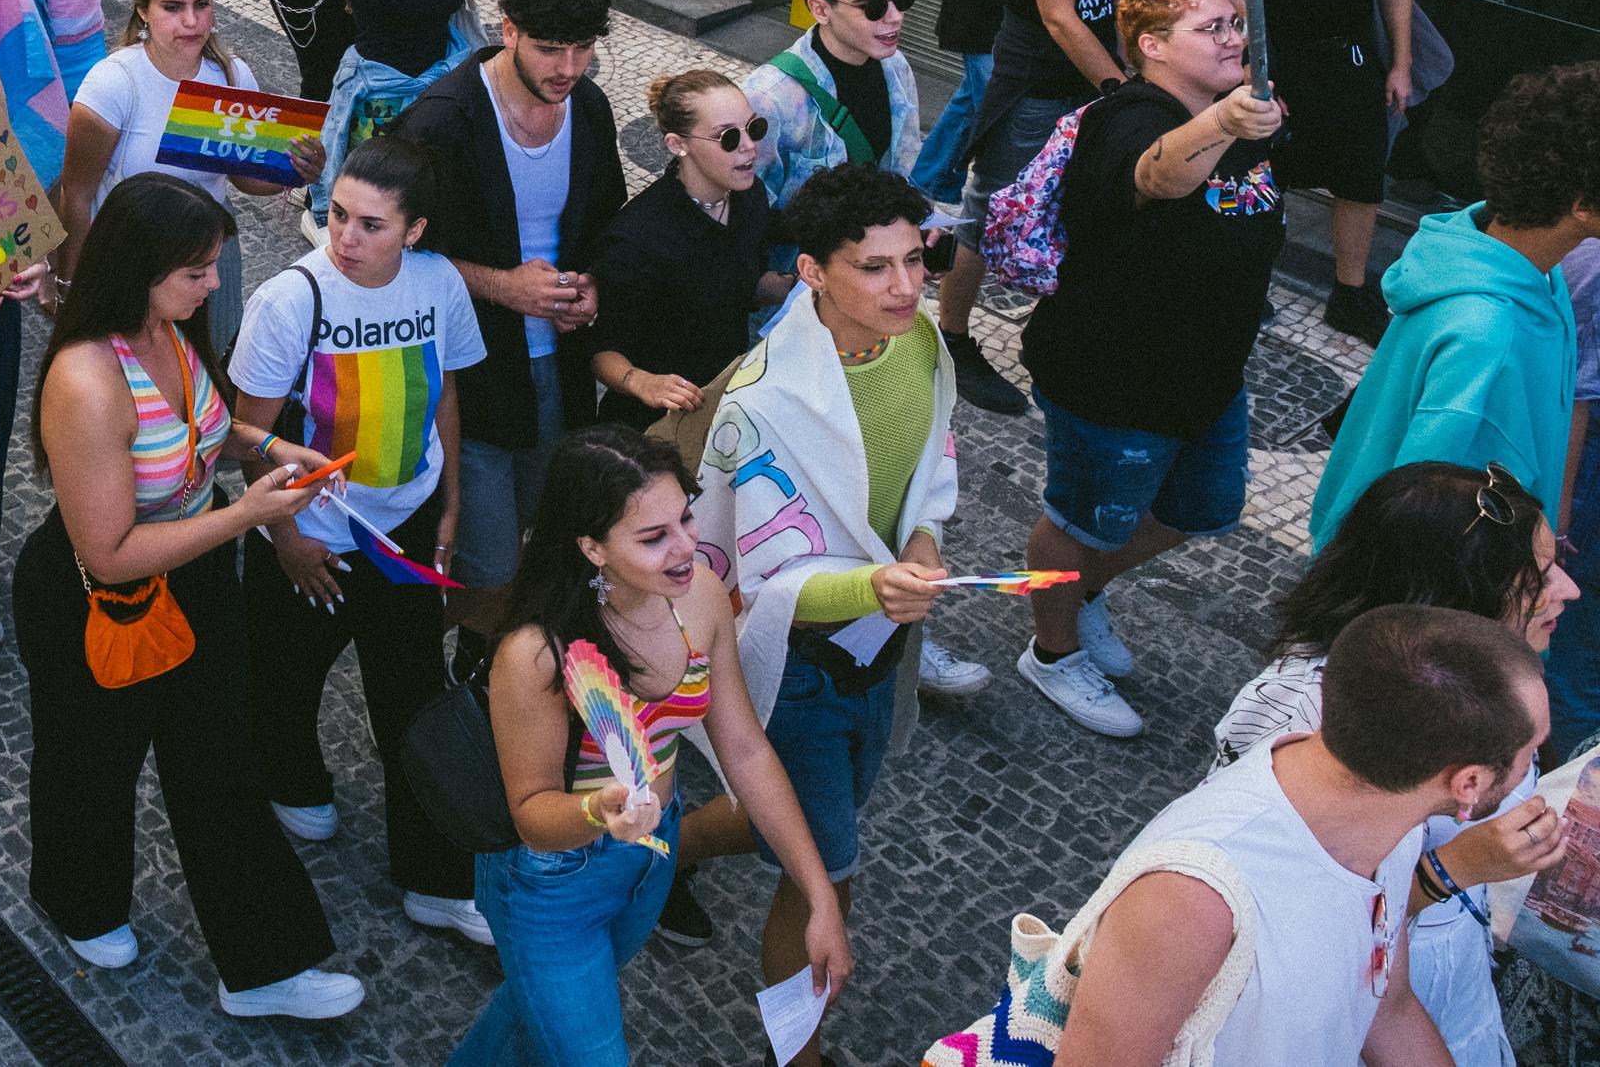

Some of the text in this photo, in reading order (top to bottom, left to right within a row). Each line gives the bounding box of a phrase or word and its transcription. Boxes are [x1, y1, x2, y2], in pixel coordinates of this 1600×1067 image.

[213, 98, 283, 124] LOVE
[218, 116, 262, 141] IS
[199, 137, 268, 165] LOVE
[312, 306, 436, 349] Polaroid
